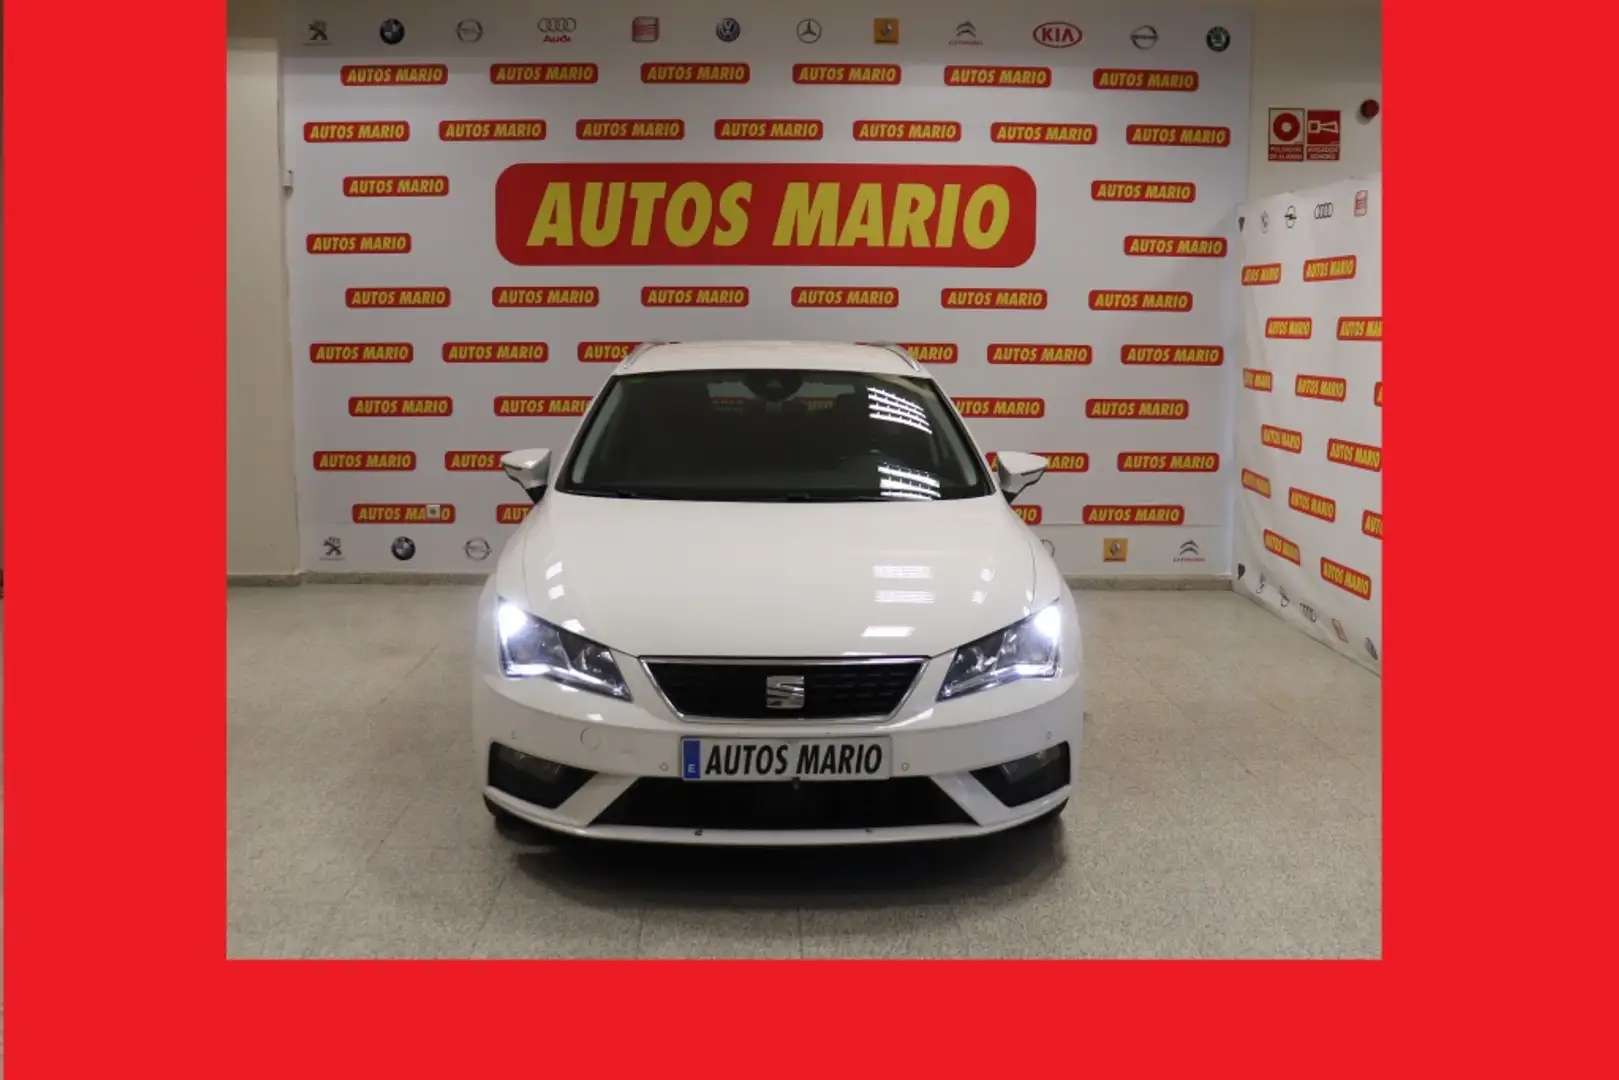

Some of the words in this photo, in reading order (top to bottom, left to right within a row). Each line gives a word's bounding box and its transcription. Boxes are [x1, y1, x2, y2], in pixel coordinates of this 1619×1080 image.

[543, 34, 572, 43] Audi
[1041, 27, 1075, 43] KIA
[347, 69, 391, 82] AUTOS
[395, 68, 443, 82] MARIO
[496, 68, 539, 80] AUTOS
[546, 67, 592, 81] MARIO
[647, 68, 693, 80] AUTOS
[695, 68, 744, 81] MARIO
[799, 68, 844, 80] AUTOS
[849, 68, 896, 81] MARIO
[950, 70, 995, 82] AUTOS
[998, 69, 1046, 83] MARIO
[1099, 72, 1145, 85] AUTOS
[1147, 74, 1193, 88] MARIO
[310, 126, 354, 139] AUTOS
[357, 125, 404, 139] MARIO
[444, 124, 489, 137] AUTOS
[492, 123, 540, 137] MARIO
[581, 123, 626, 137] AUTOS
[630, 124, 680, 137] MARIO
[722, 123, 765, 137] AUTOS
[770, 122, 817, 137] MARIO
[859, 125, 905, 137] AUTOS
[908, 125, 956, 138] MARIO
[997, 126, 1042, 139] AUTOS
[1045, 127, 1093, 140] MARIO
[1132, 127, 1176, 141] AUTOS
[1180, 130, 1226, 143] MARIO
[349, 180, 393, 194] AUTOS
[396, 180, 444, 193] MARIO
[1098, 183, 1141, 197] AUTOS
[1142, 184, 1191, 199] MARIO
[526, 181, 753, 249] AUTOS
[771, 182, 1011, 250] MARIO
[314, 237, 355, 251] AUTOS
[360, 237, 406, 251] MARIO
[1130, 239, 1173, 252] AUTOS
[1176, 240, 1223, 253] MARIO
[1306, 261, 1329, 278] AUTOS
[1330, 258, 1355, 276] MARIO
[351, 291, 397, 305] AUTOS
[399, 290, 446, 304] MARIO
[499, 291, 544, 304] AUTOS
[547, 290, 594, 303] MARIO
[646, 290, 693, 302] AUTOS
[695, 290, 745, 302] MARIO
[798, 291, 842, 303] AUTOS
[845, 291, 893, 304] MARIO
[947, 292, 991, 305] AUTOS
[996, 292, 1042, 306] MARIO
[1095, 294, 1138, 307] AUTOS
[1141, 294, 1188, 307] MARIO
[1267, 320, 1289, 336] AUTOS
[1289, 320, 1312, 337] MARIO
[1339, 320, 1365, 337] AUTOS
[315, 347, 360, 360] AUTOS
[361, 346, 409, 360] MARIO
[448, 346, 493, 359] AUTOS
[494, 345, 544, 358] MARIO
[583, 345, 629, 359] AUTOS
[1126, 349, 1170, 361] AUTOS
[1173, 349, 1218, 362] MARIO
[1296, 377, 1319, 395] AUTOS
[1320, 380, 1346, 399] MARIO
[354, 399, 397, 414] AUTOS
[400, 401, 448, 413] MARIO
[500, 399, 544, 412] AUTOS
[548, 399, 587, 413] MARI
[956, 401, 990, 414] UTOS
[991, 401, 1040, 414] MARIO
[1092, 403, 1136, 415] AUTOS
[1138, 403, 1184, 416] MARIO
[319, 455, 362, 467] AUTOS
[365, 455, 411, 467] MARIO
[451, 454, 495, 468] AUTOS
[1124, 456, 1164, 469] AUTOS
[1170, 455, 1213, 469] MARIO
[1328, 443, 1353, 461] AUTOS
[1354, 447, 1380, 469] MARIO
[1290, 491, 1312, 510] AUTOS
[1311, 497, 1335, 518] MARIO
[357, 507, 399, 520] AUTOS
[405, 507, 451, 521] MAO
[1089, 509, 1131, 521] AUTOS
[1134, 509, 1179, 521] MARIO
[1322, 562, 1345, 584] AUTOS
[1344, 570, 1370, 595] MARIO
[704, 744, 789, 775] AUTOS
[795, 744, 883, 775] MARIO
[687, 763, 698, 774] E
